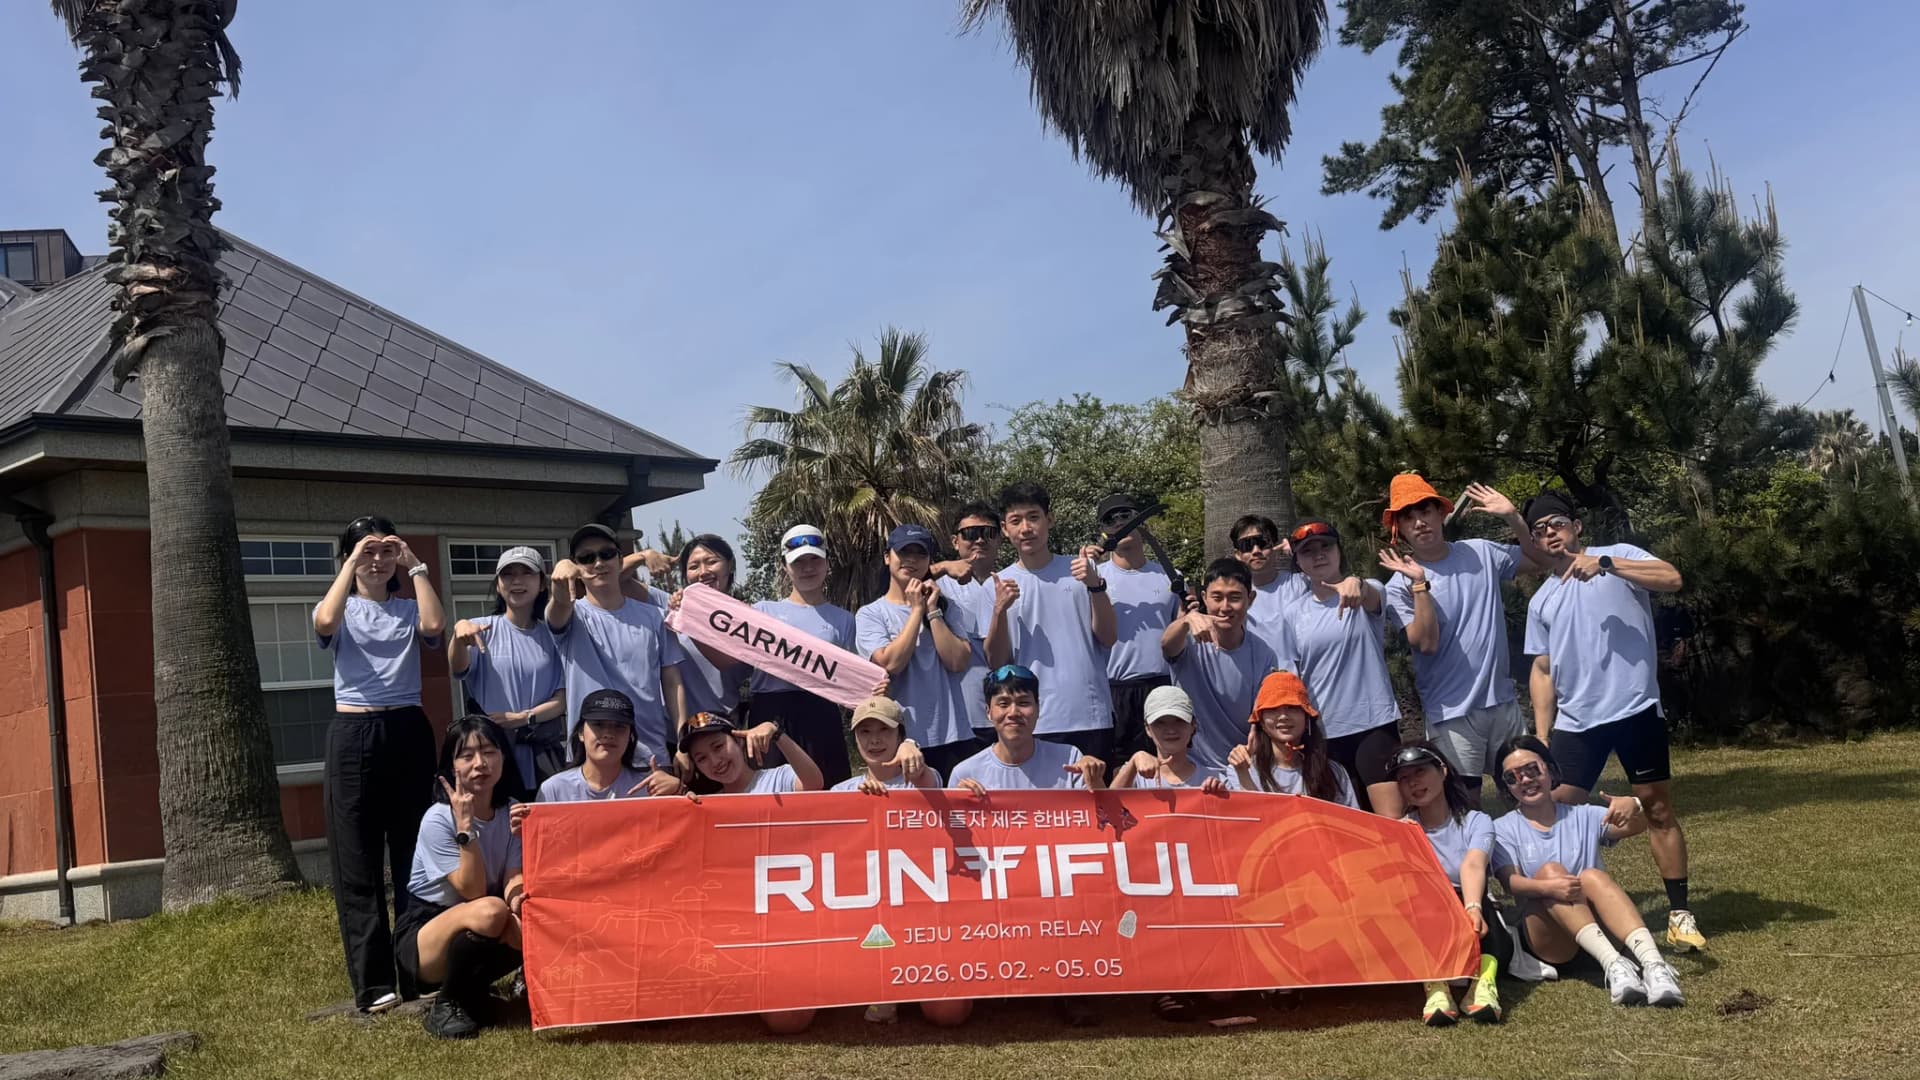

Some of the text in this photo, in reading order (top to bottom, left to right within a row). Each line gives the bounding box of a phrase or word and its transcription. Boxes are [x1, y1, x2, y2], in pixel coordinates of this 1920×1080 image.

[709, 609, 838, 681] GARMIN
[886, 809, 1091, 829] 다같이 돌자 제주 한바퀴
[903, 919, 1102, 944] JEJU 240km RELAY
